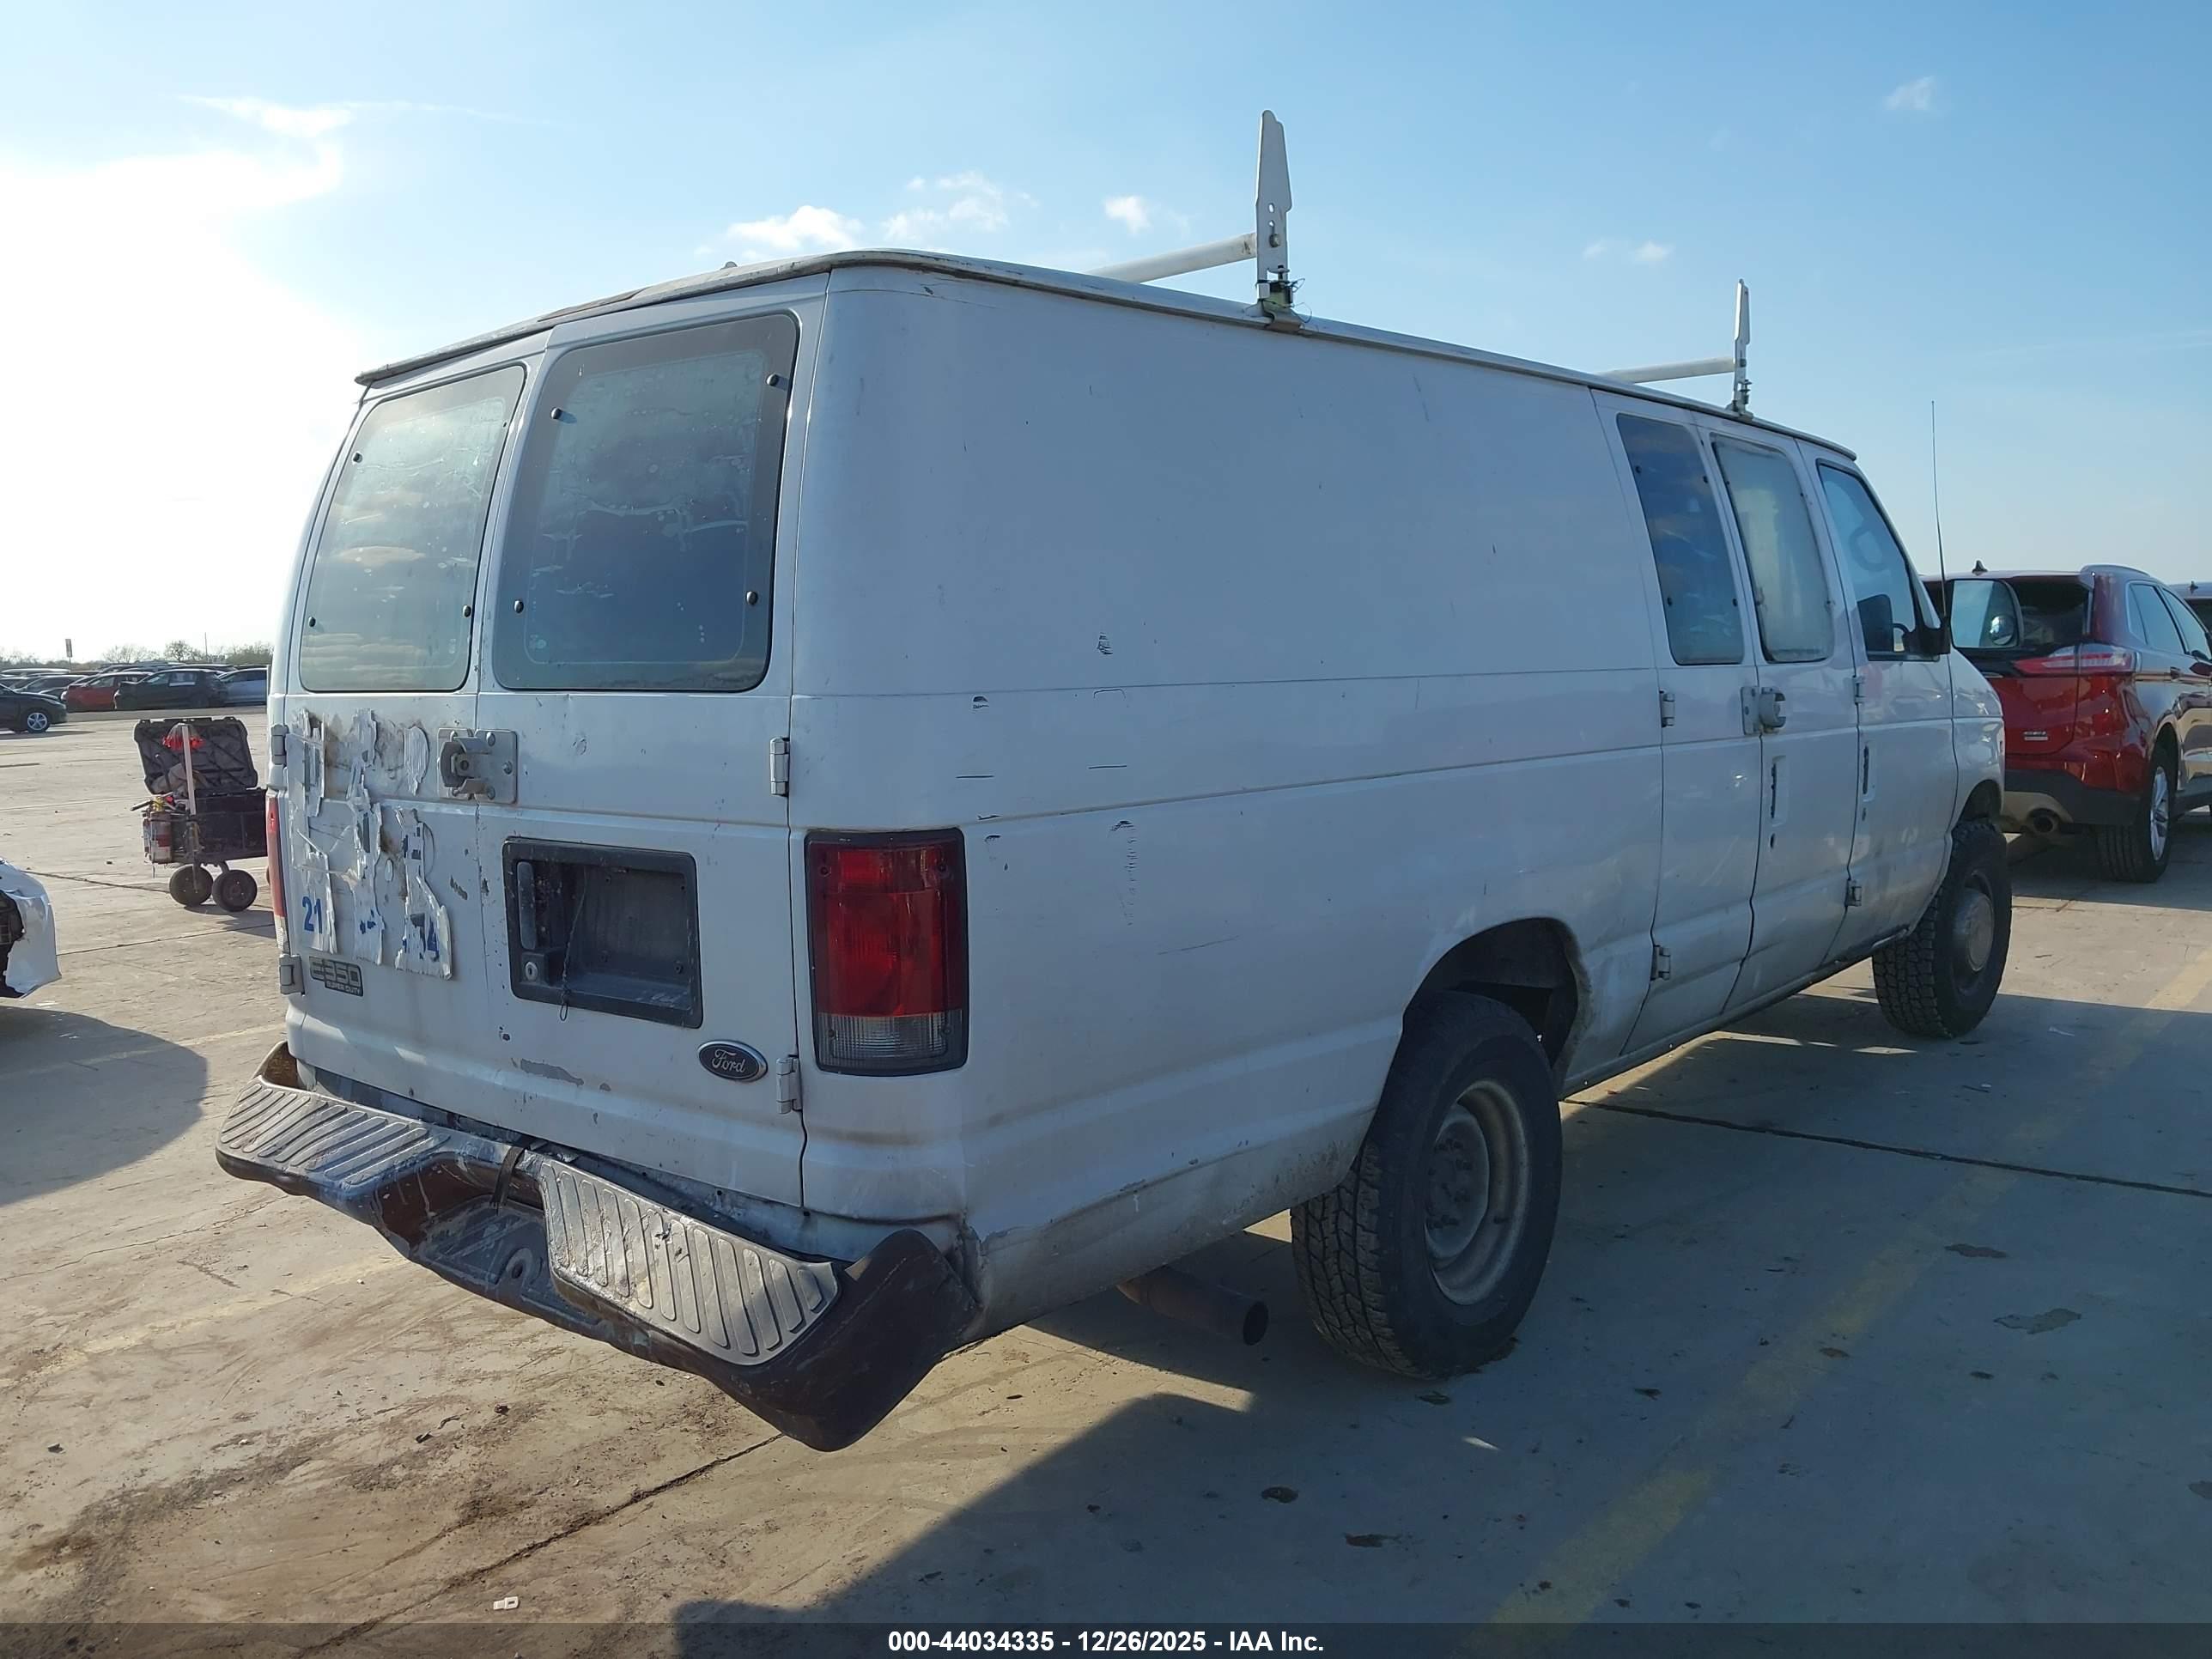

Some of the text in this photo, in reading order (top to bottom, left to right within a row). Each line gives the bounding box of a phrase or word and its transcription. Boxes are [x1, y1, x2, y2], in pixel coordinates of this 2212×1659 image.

[302, 896, 323, 934] 21
[310, 957, 361, 988] E350
[712, 1049, 745, 1073] Ford
